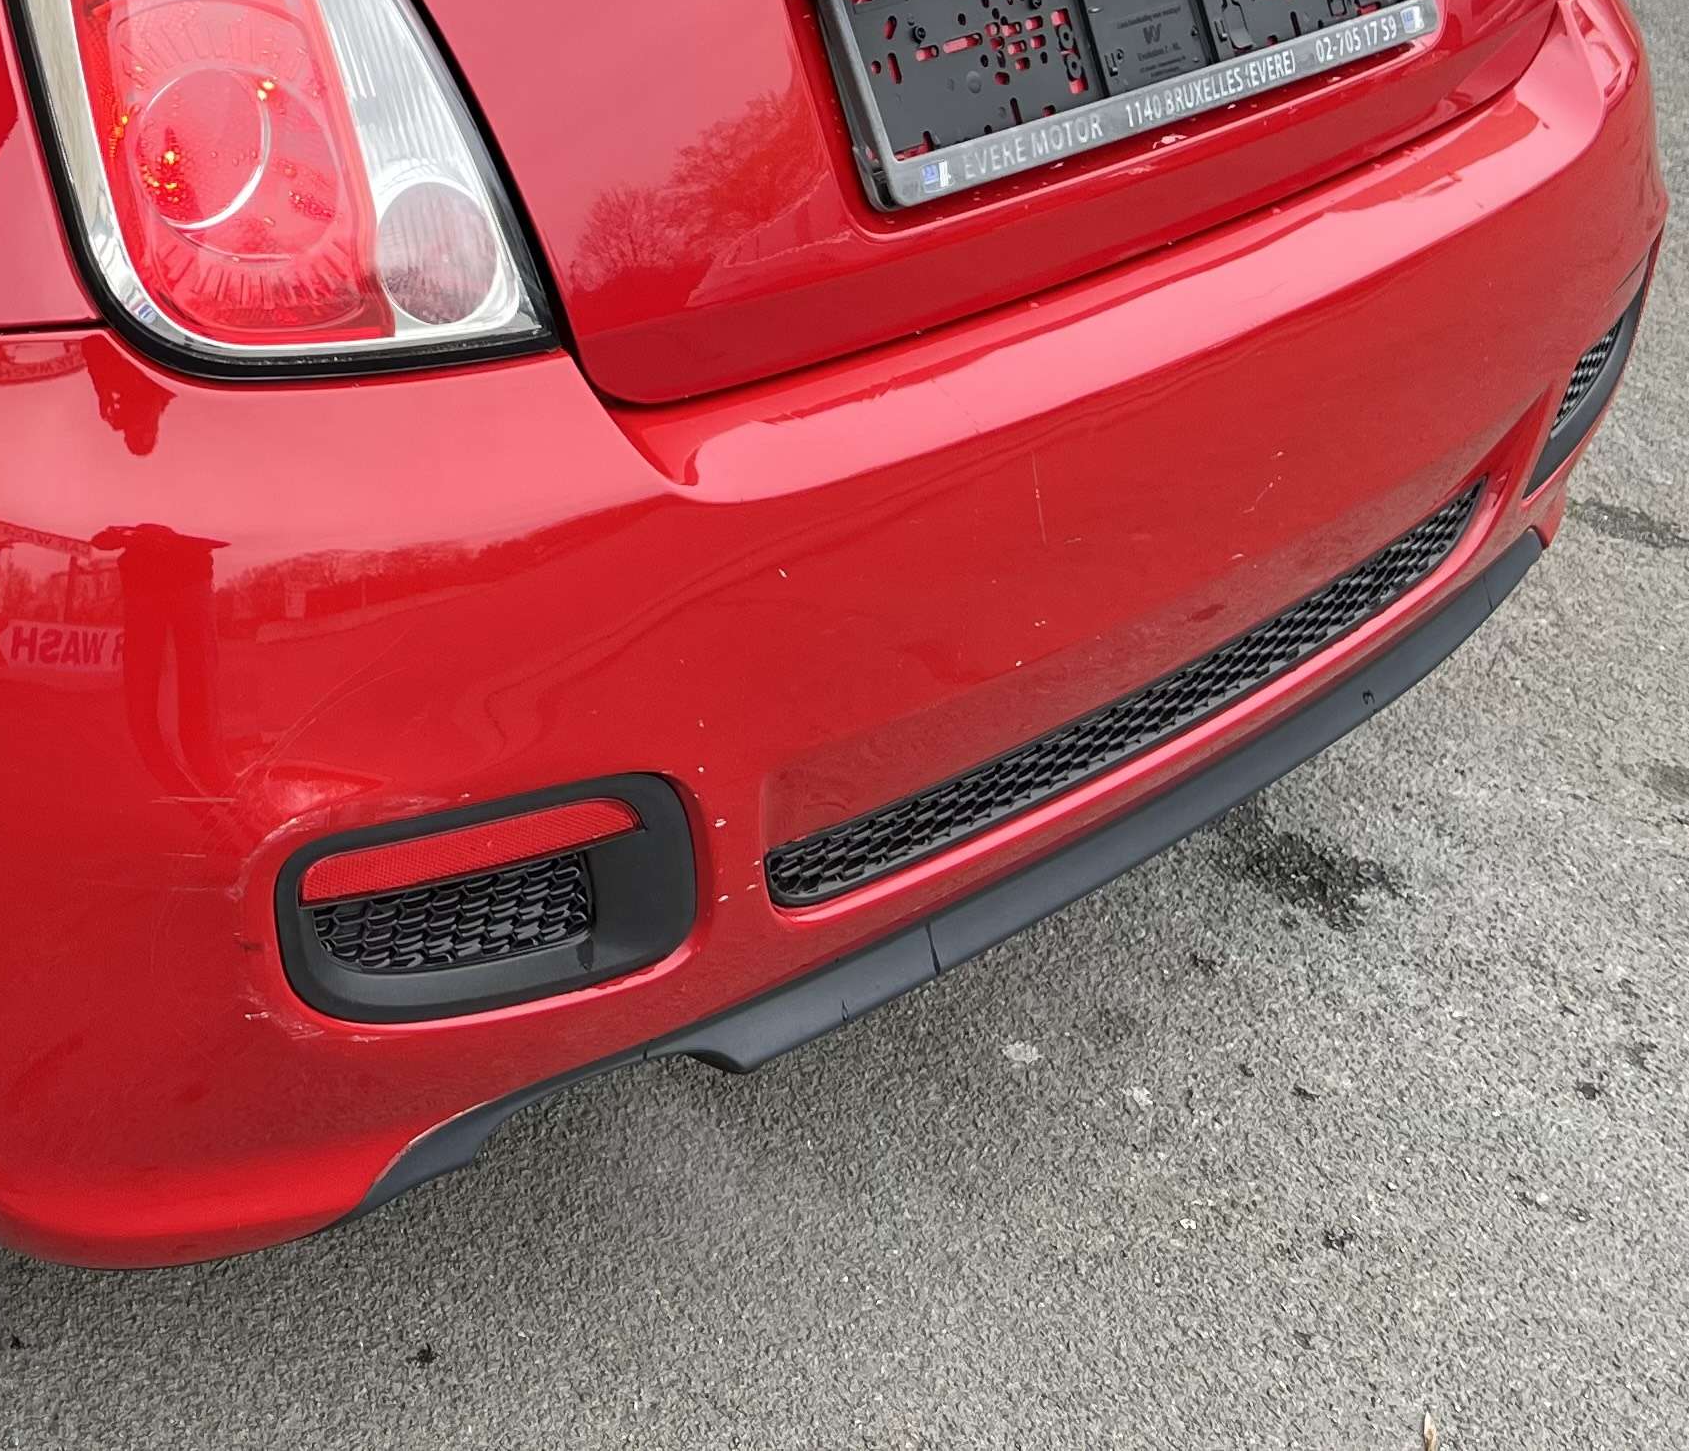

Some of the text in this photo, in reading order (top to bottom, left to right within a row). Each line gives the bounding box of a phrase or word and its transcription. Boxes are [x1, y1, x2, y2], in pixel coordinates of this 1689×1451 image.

[963, 15, 1397, 180] EVERE MOTOR 1140 BRUXELLES (EVERE) 02-705 17 59
